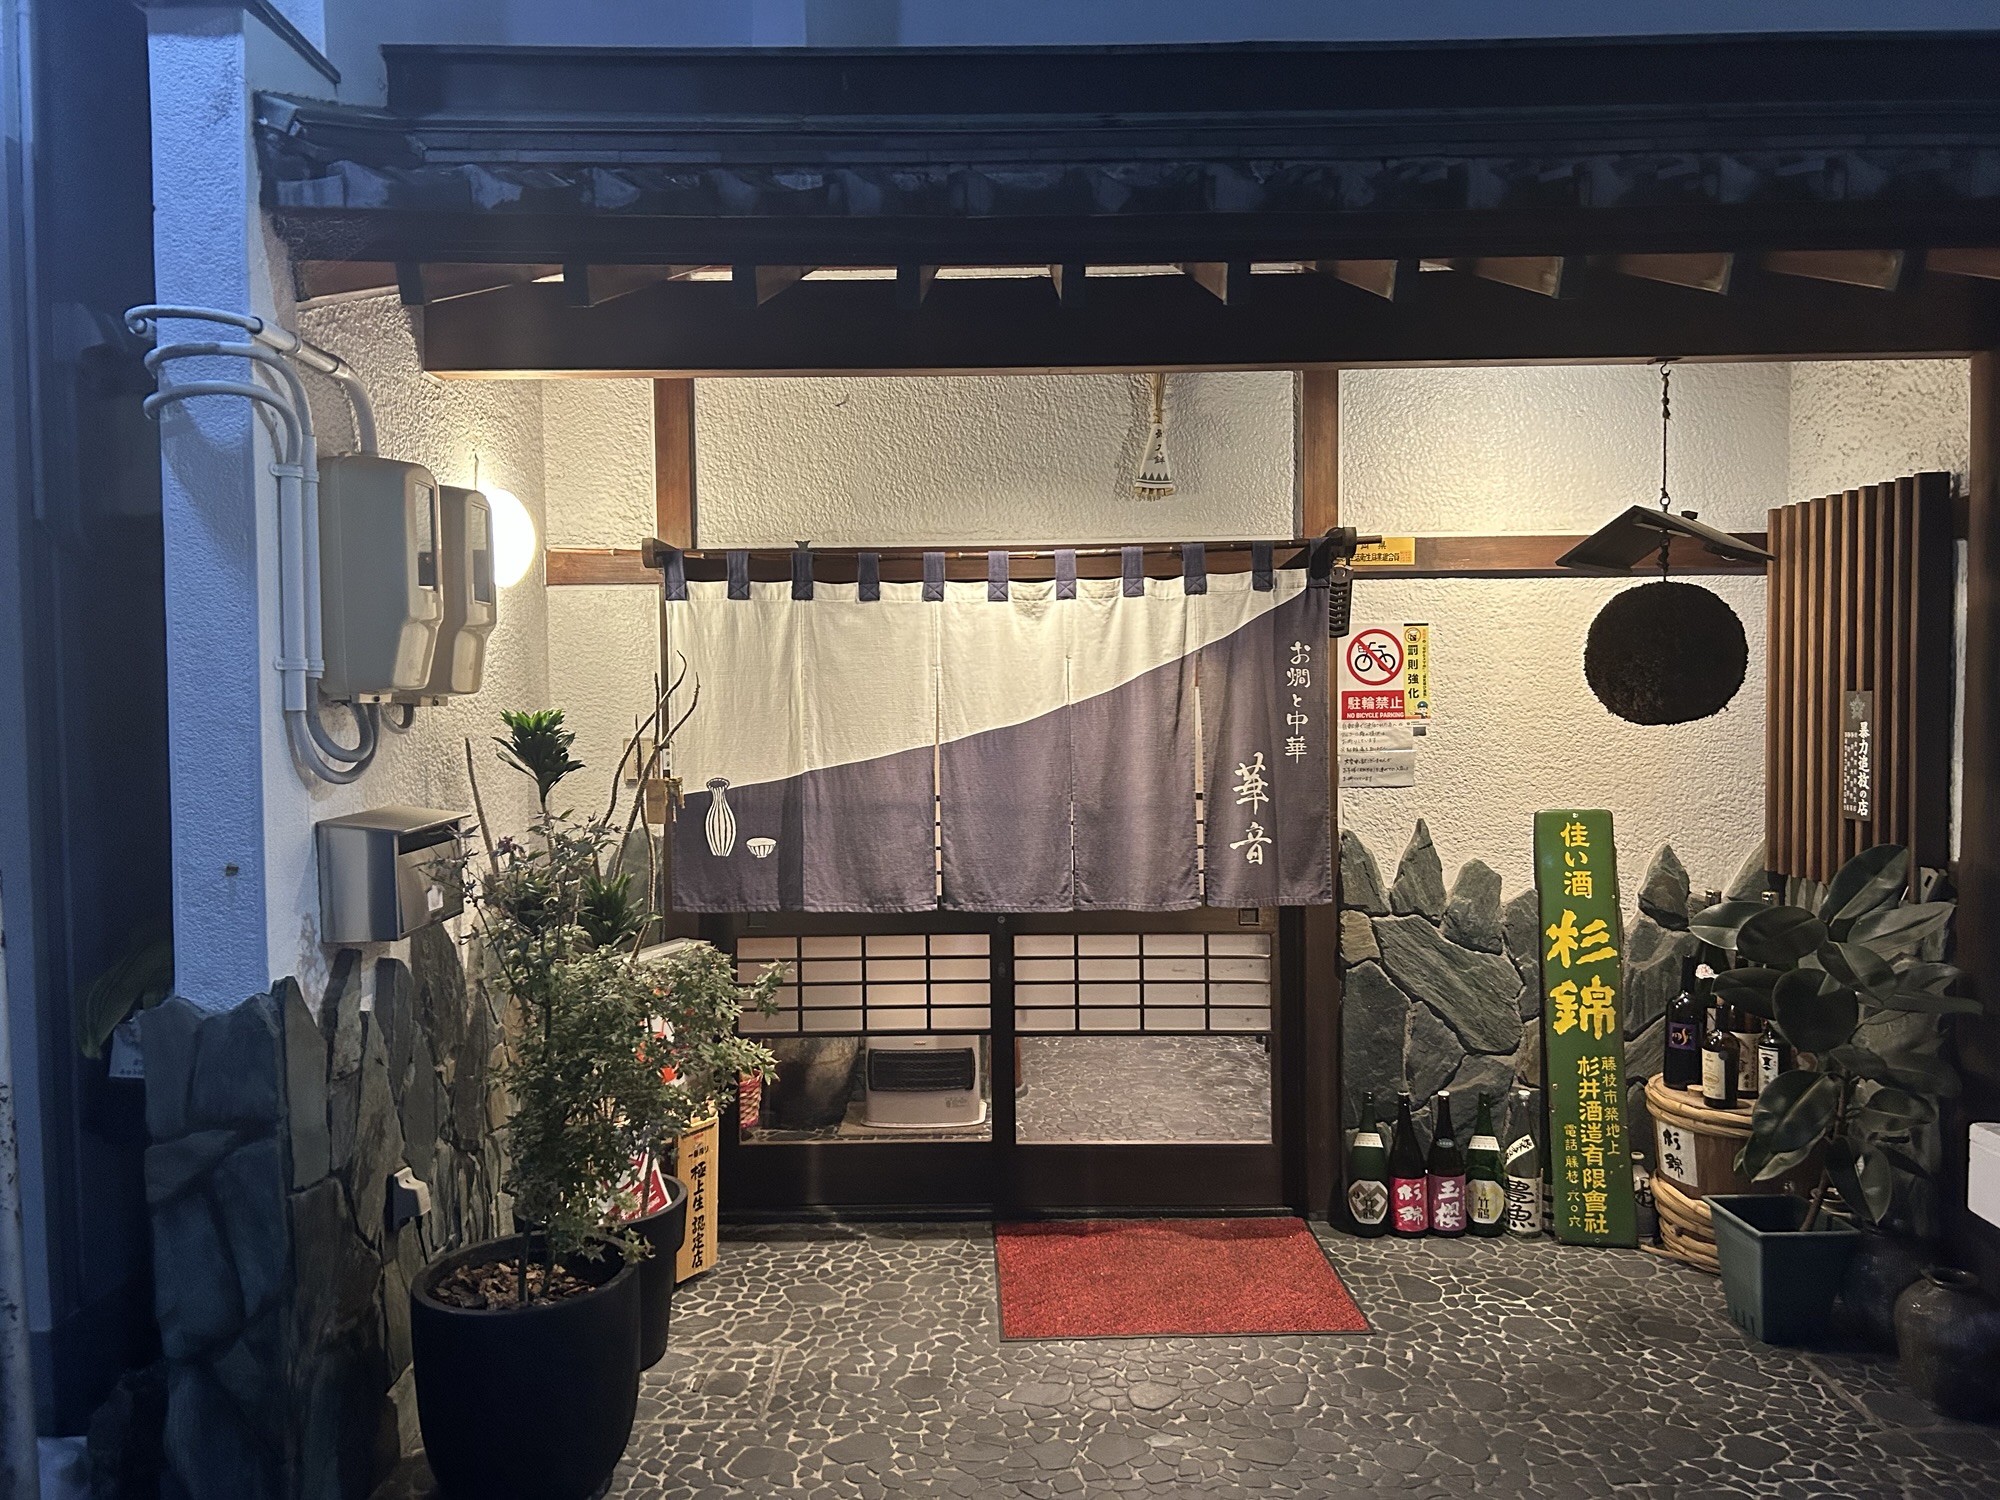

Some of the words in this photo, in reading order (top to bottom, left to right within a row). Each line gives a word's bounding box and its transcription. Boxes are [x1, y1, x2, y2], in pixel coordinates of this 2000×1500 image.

[1284, 640, 1312, 764] お燗と中華
[1347, 696, 1404, 710] 駐輪禁止
[1407, 645, 1420, 699] 罰則強化
[1230, 751, 1282, 865] 華音
[1857, 721, 1870, 817] 暴力追放の店
[1560, 821, 1593, 898] 佳い酒
[1545, 908, 1618, 1040] 杉錦
[1563, 1123, 1578, 1151] 電話
[1577, 1055, 1610, 1234] 杉井酒造有限會社
[1601, 1056, 1621, 1155] 藤枝市築地上
[691, 1214, 706, 1269] 認定店
